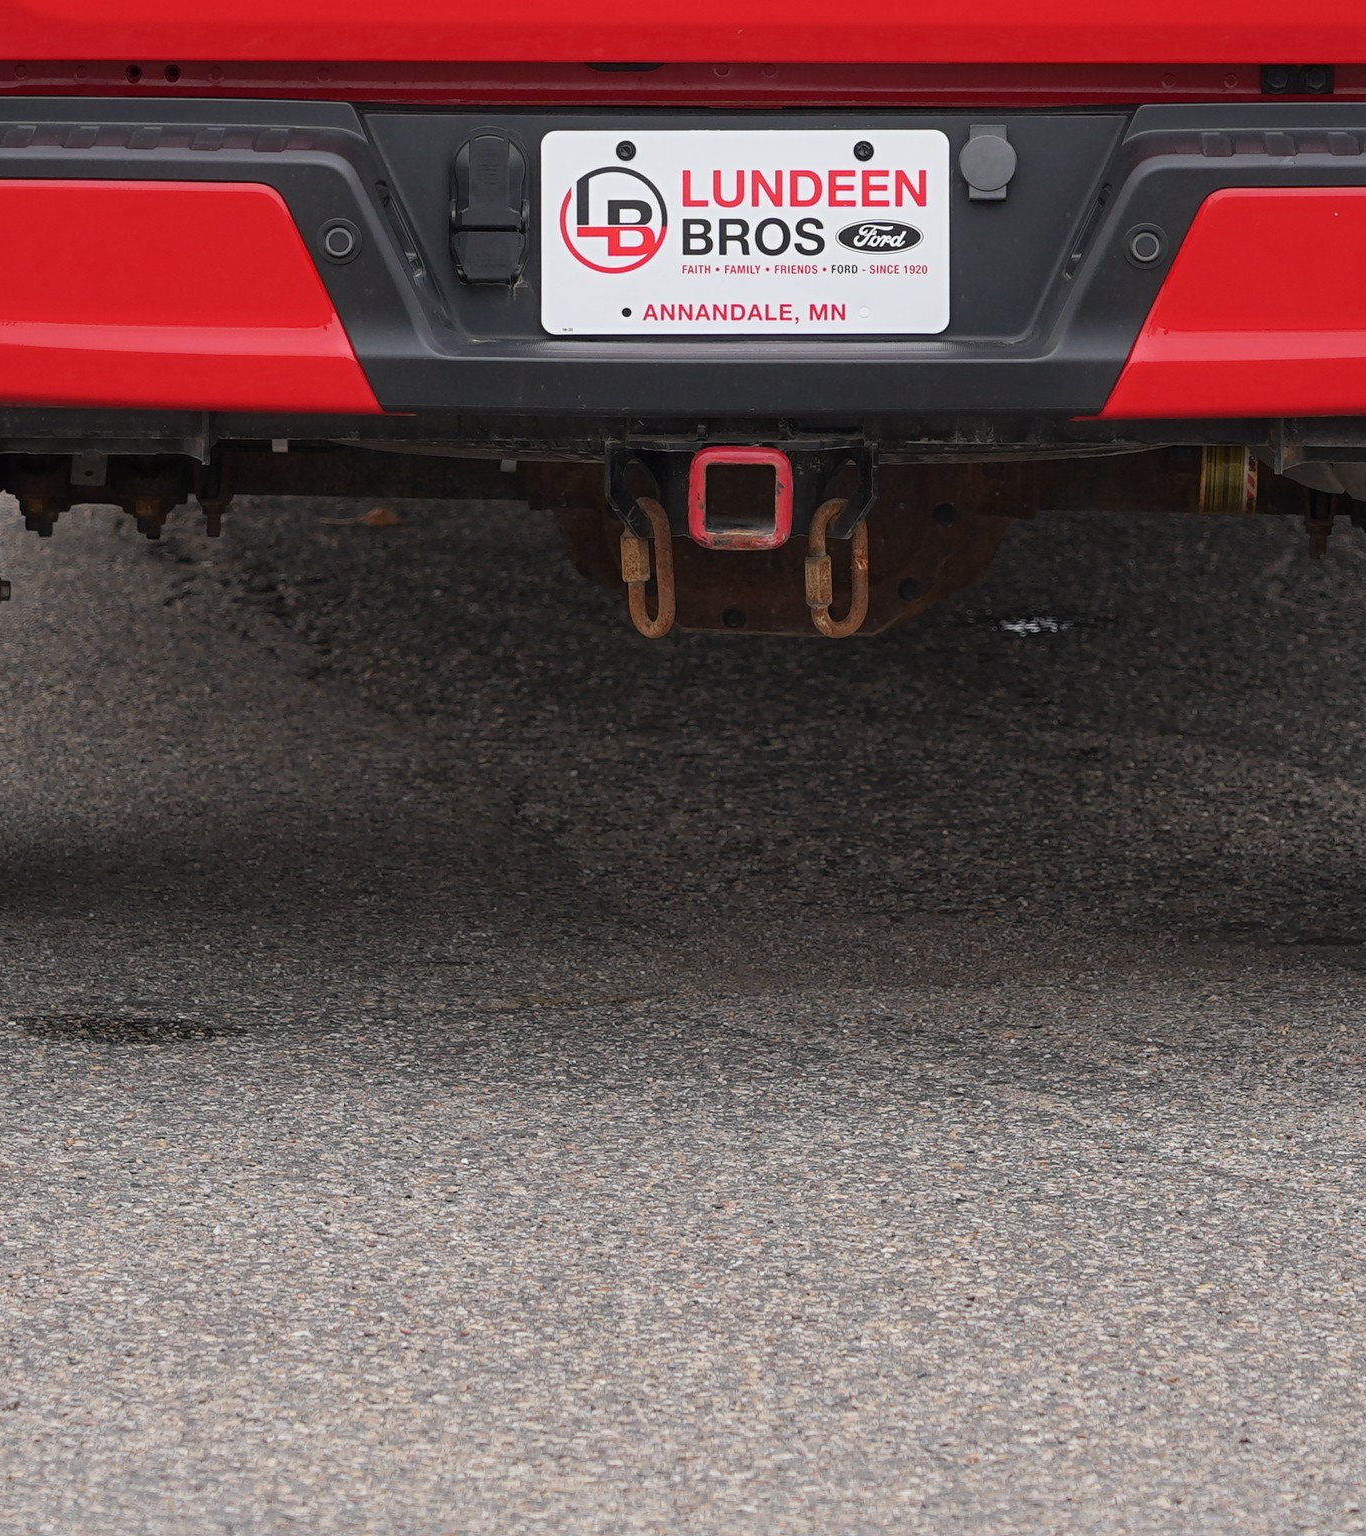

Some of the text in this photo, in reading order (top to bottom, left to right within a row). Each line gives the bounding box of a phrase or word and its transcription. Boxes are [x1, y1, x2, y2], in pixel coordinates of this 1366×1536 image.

[681, 169, 927, 207] LUNDEEN
[682, 217, 906, 256] BROS Ford
[682, 264, 928, 275] FAITH FAMILY FRIENDS FORD SINCE 1920
[643, 304, 846, 324] ANNANDALE, MN
